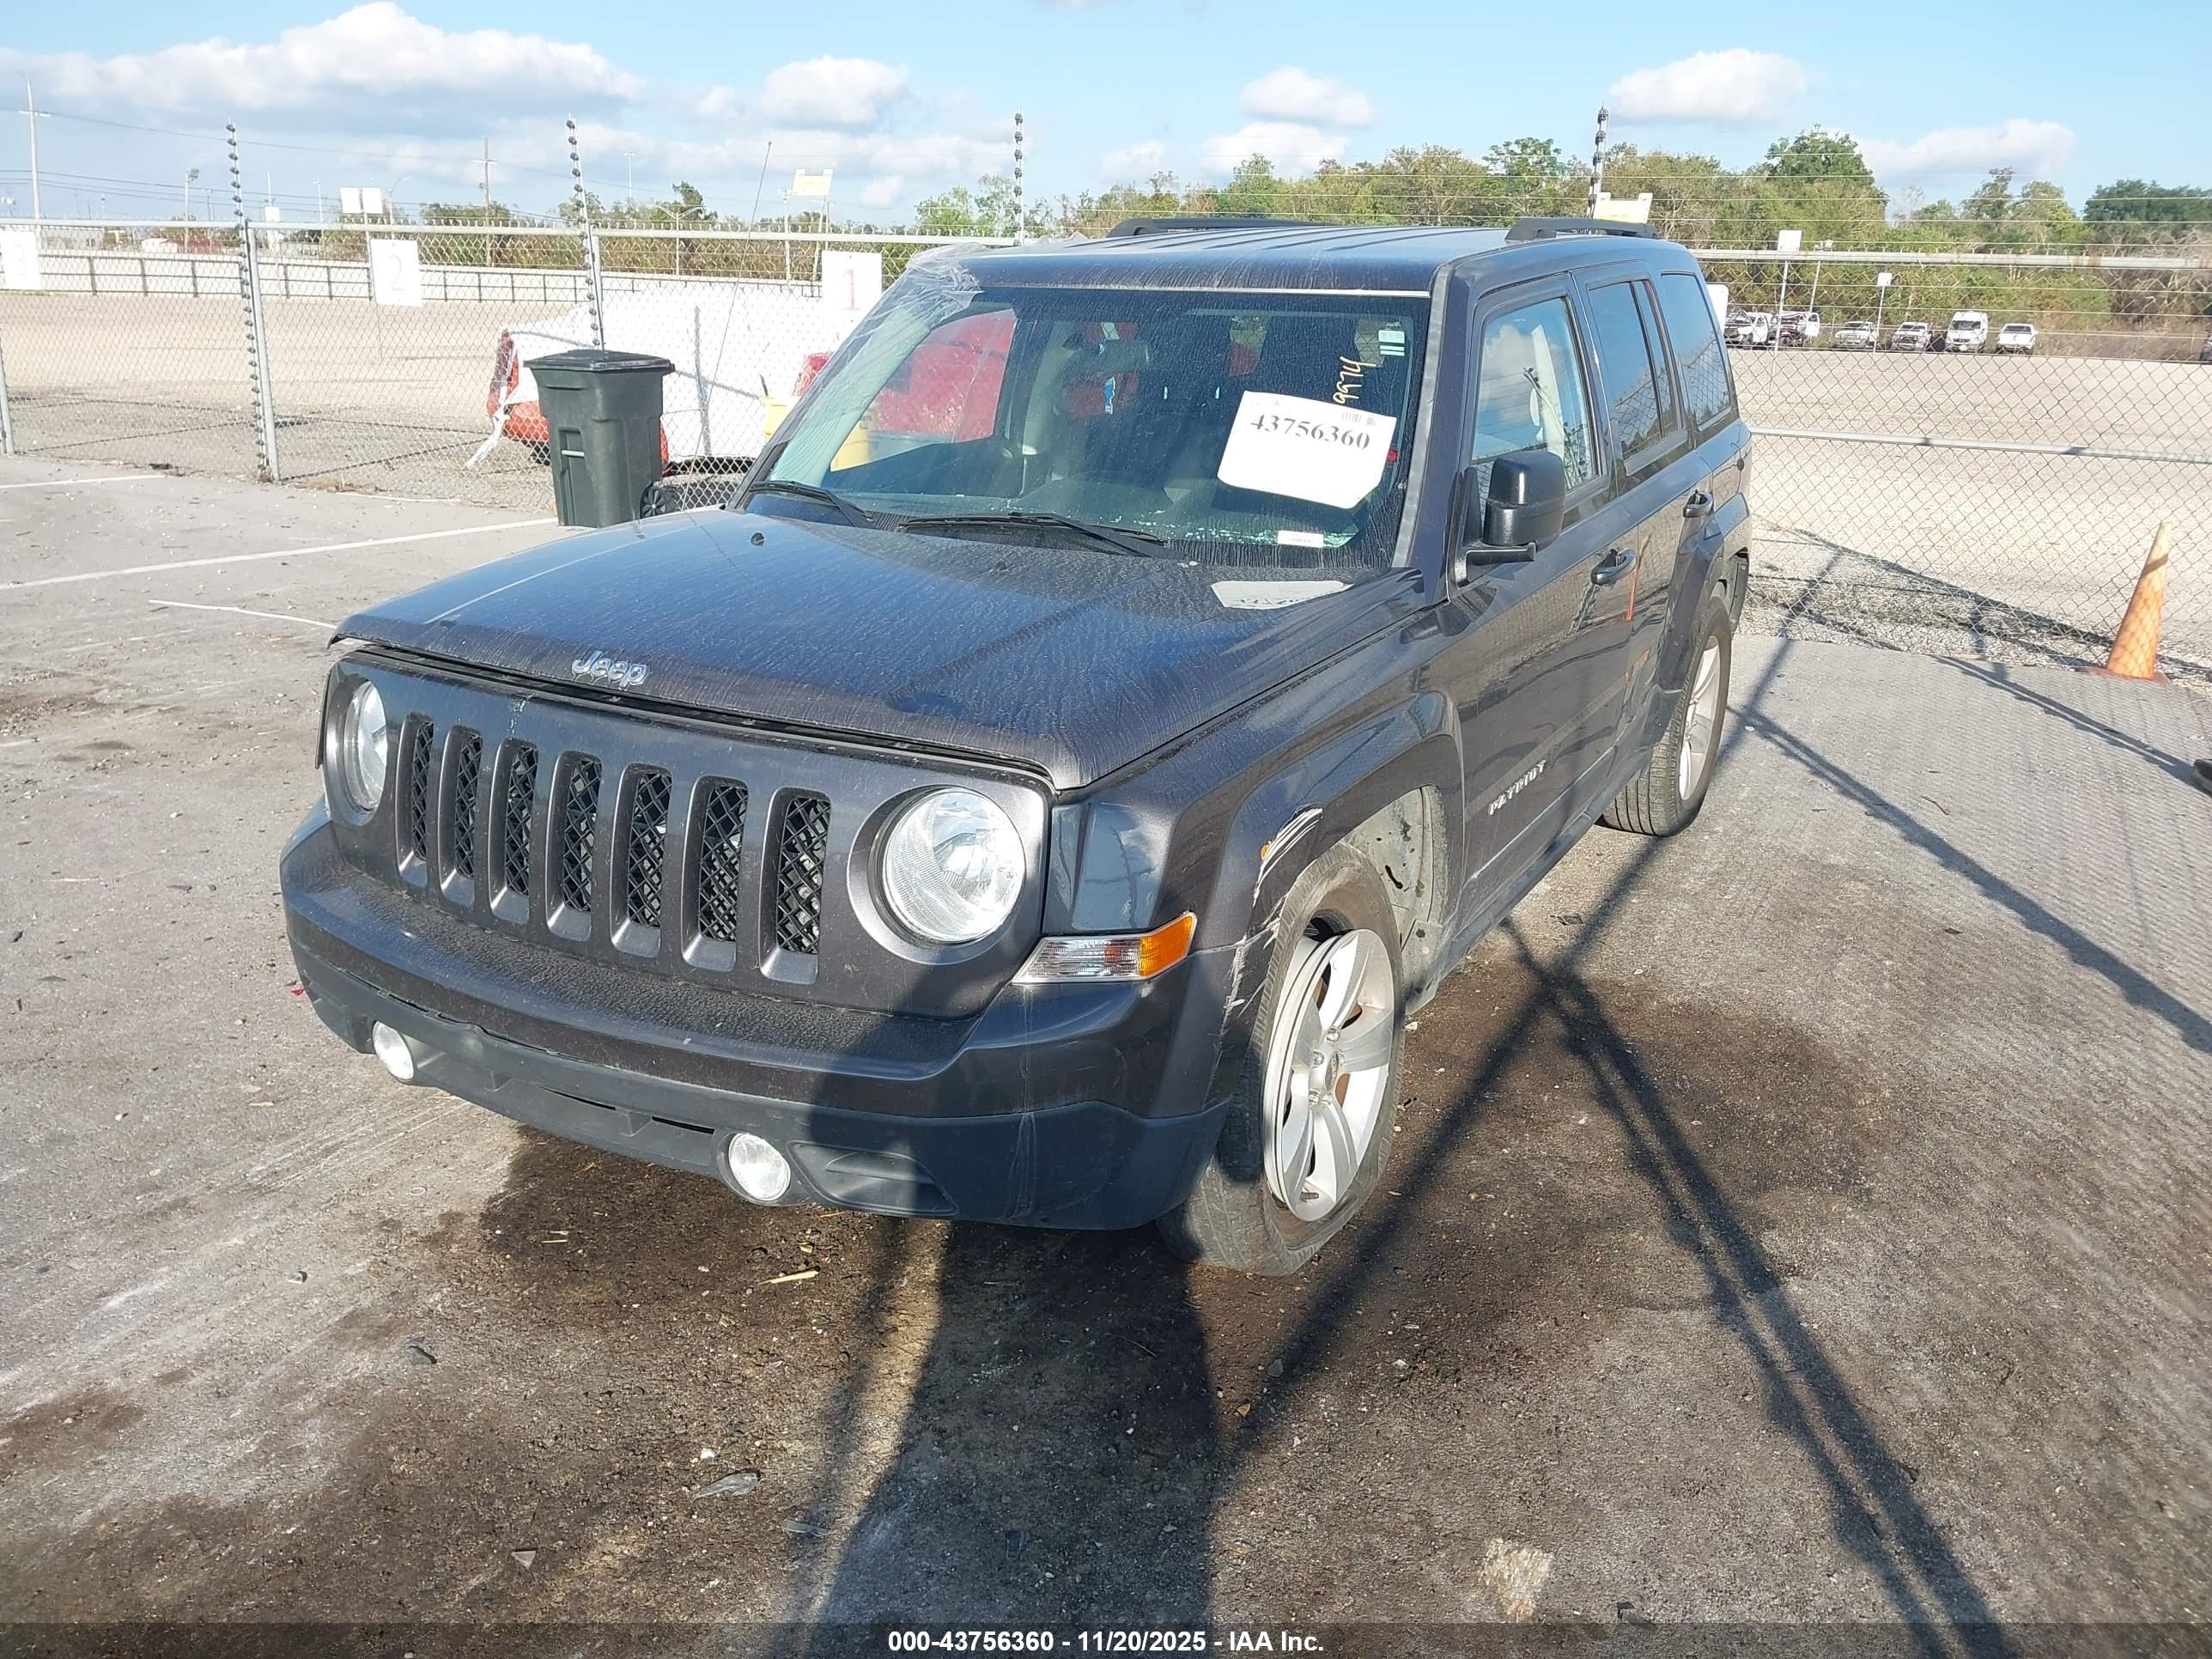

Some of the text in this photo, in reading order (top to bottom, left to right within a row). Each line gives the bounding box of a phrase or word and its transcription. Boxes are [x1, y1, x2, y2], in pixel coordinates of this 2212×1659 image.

[14, 244, 27, 277] 3
[387, 253, 406, 292] 2
[842, 268, 861, 312] 1
[1251, 414, 1370, 449] 43756360
[571, 650, 648, 689] Jeep
[1488, 759, 1547, 817] PATRIOT
